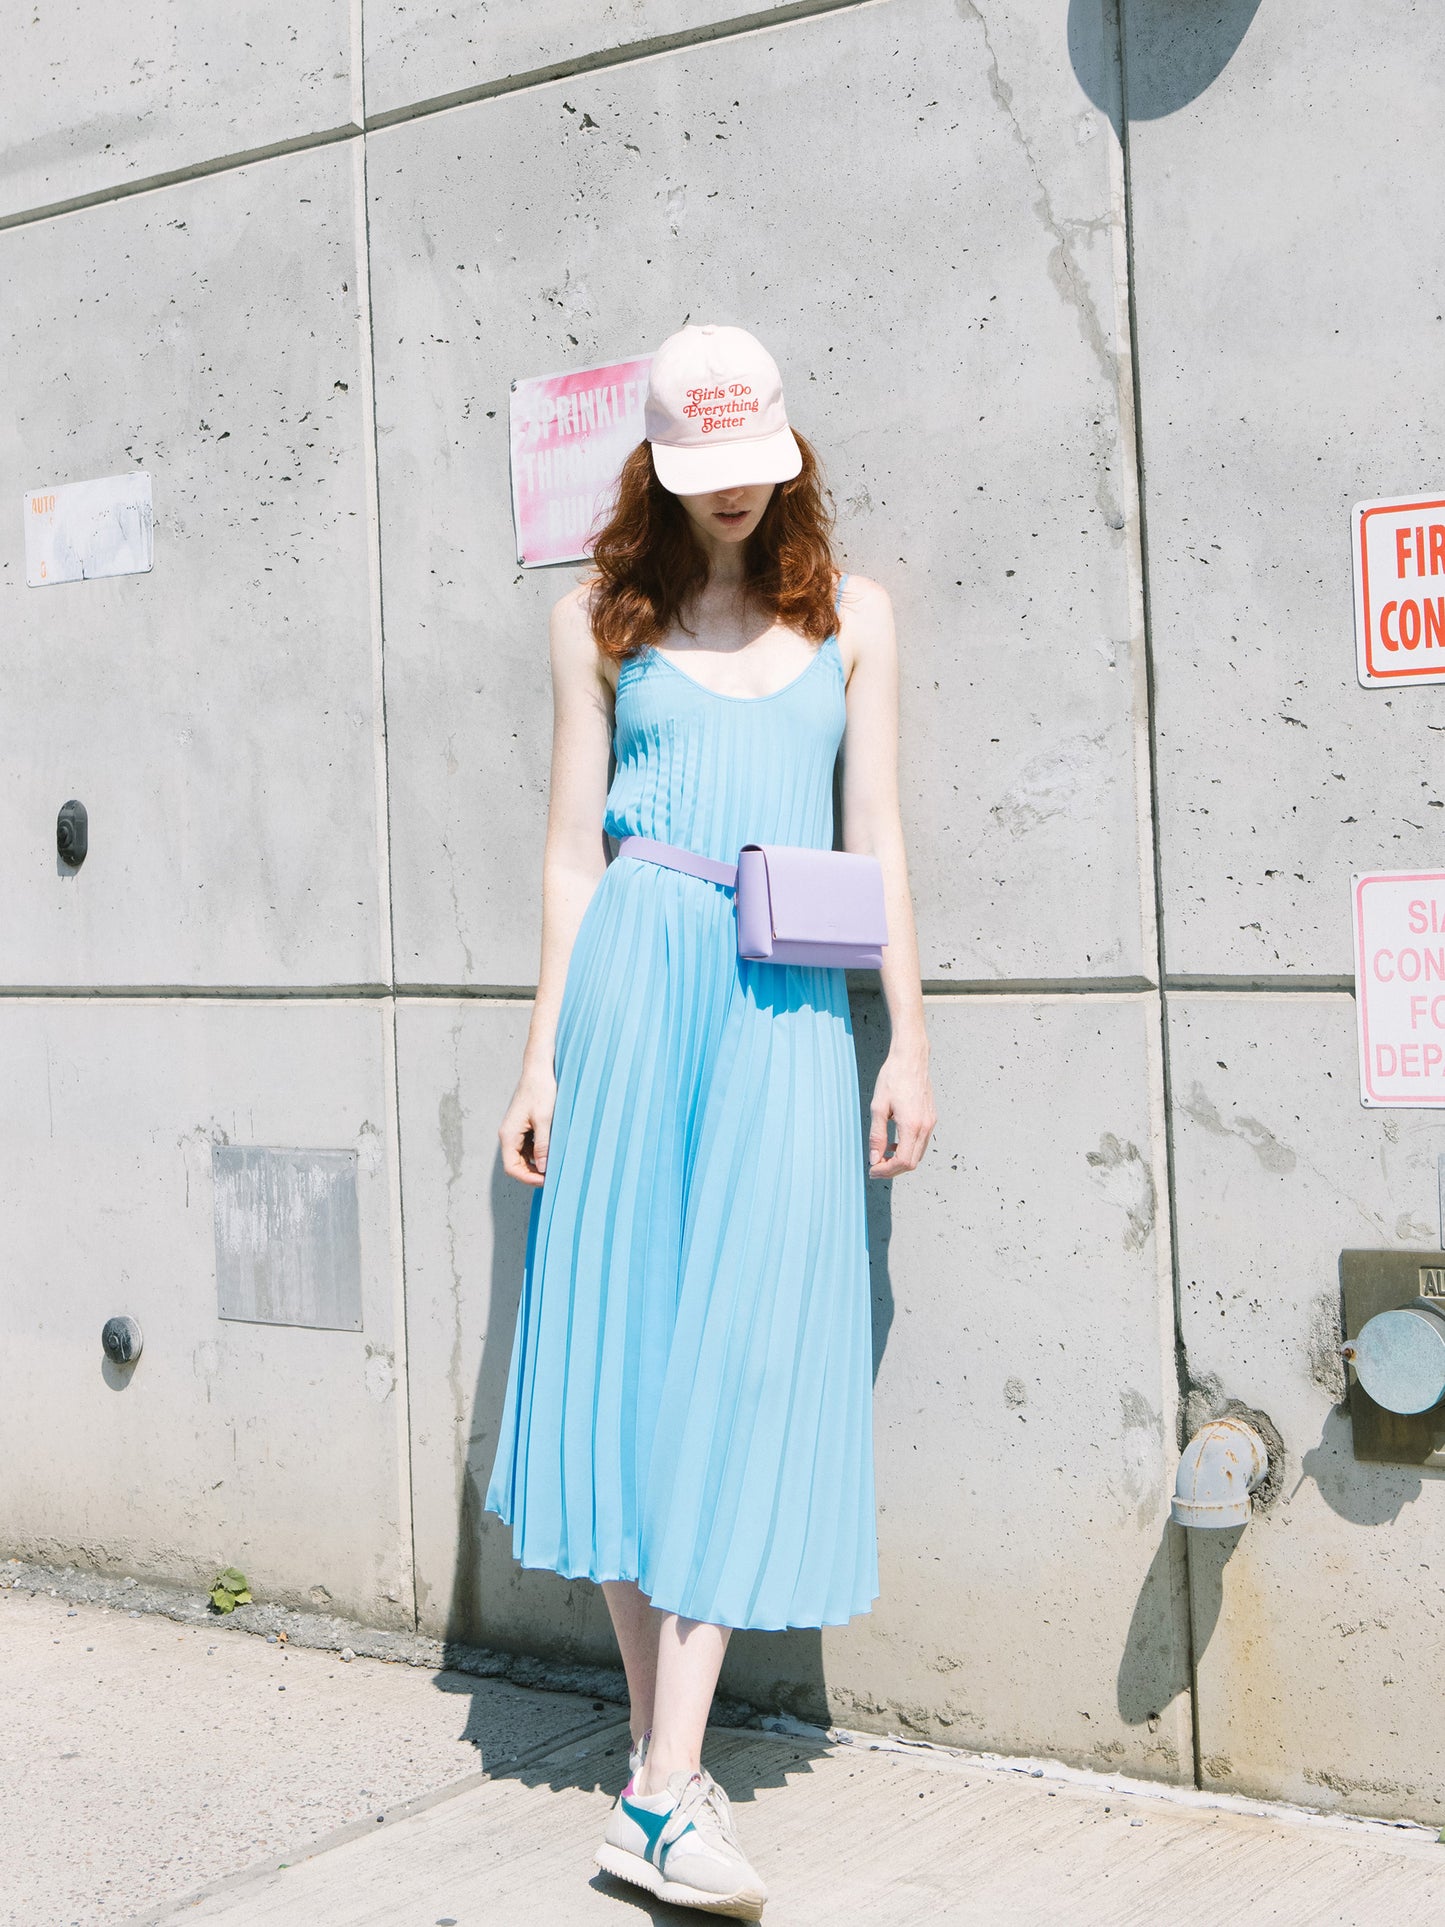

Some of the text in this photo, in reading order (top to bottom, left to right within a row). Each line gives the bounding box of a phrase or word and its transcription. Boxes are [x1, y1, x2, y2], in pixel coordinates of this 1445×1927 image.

[525, 378, 648, 443] SPRINKLE
[682, 398, 759, 418] Everything
[686, 383, 752, 405] Girls Do
[701, 417, 746, 434] Better
[1395, 524, 1445, 579] FIR
[1379, 596, 1445, 652] CON
[1407, 899, 1445, 934] SI
[1373, 947, 1445, 983] CON
[1375, 1043, 1445, 1078] DEP
